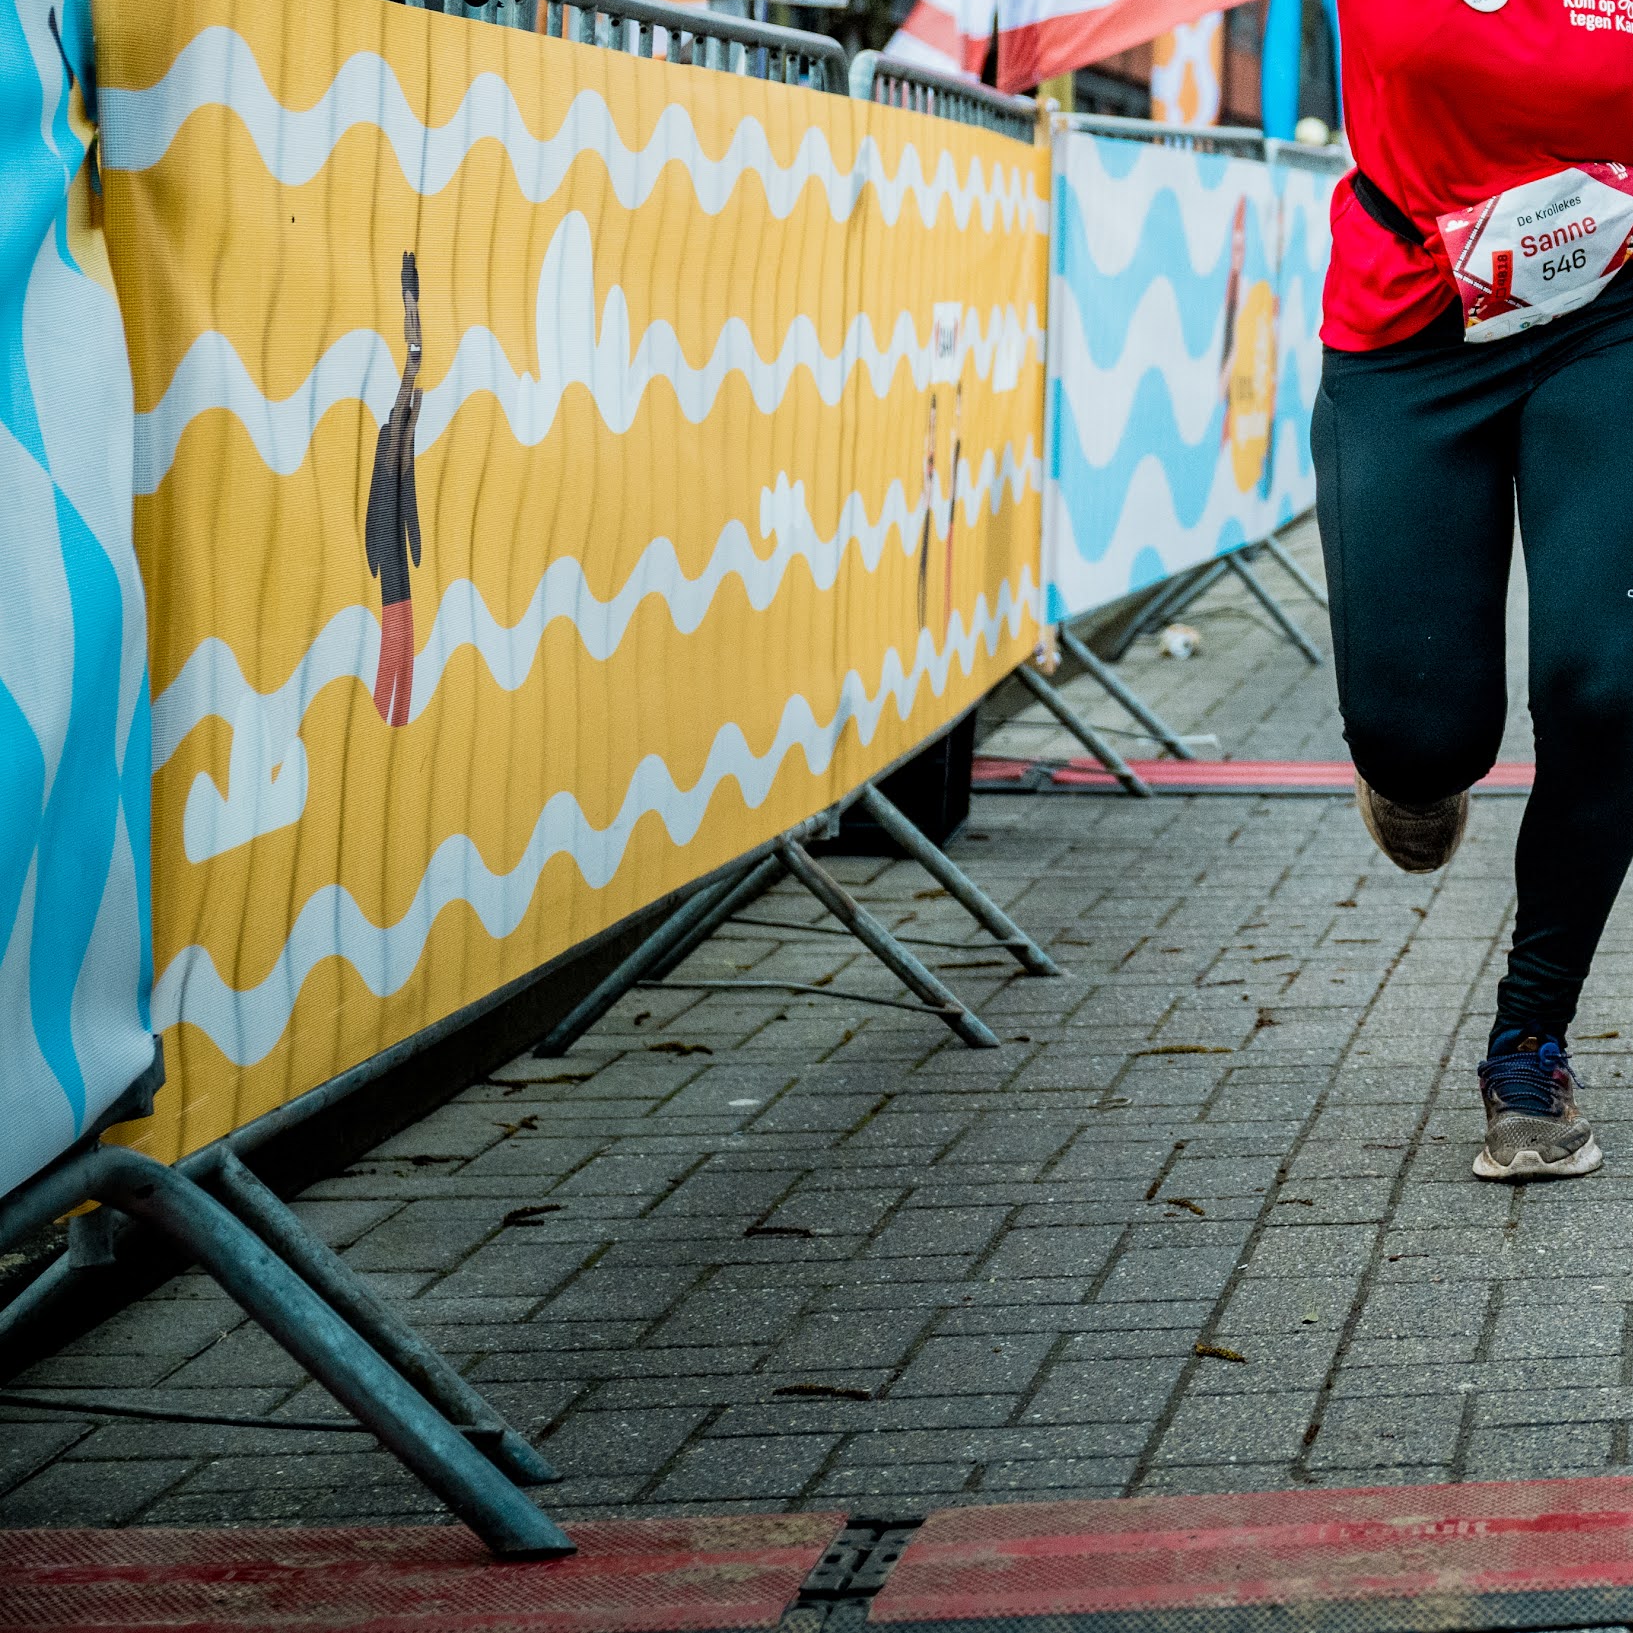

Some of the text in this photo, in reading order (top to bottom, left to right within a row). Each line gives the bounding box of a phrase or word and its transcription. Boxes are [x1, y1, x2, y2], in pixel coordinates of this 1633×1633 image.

[1570, 9, 1612, 32] tegen
[1516, 195, 1582, 227] De Krollekes
[1519, 215, 1598, 259] Sanne
[1541, 248, 1588, 282] 546
